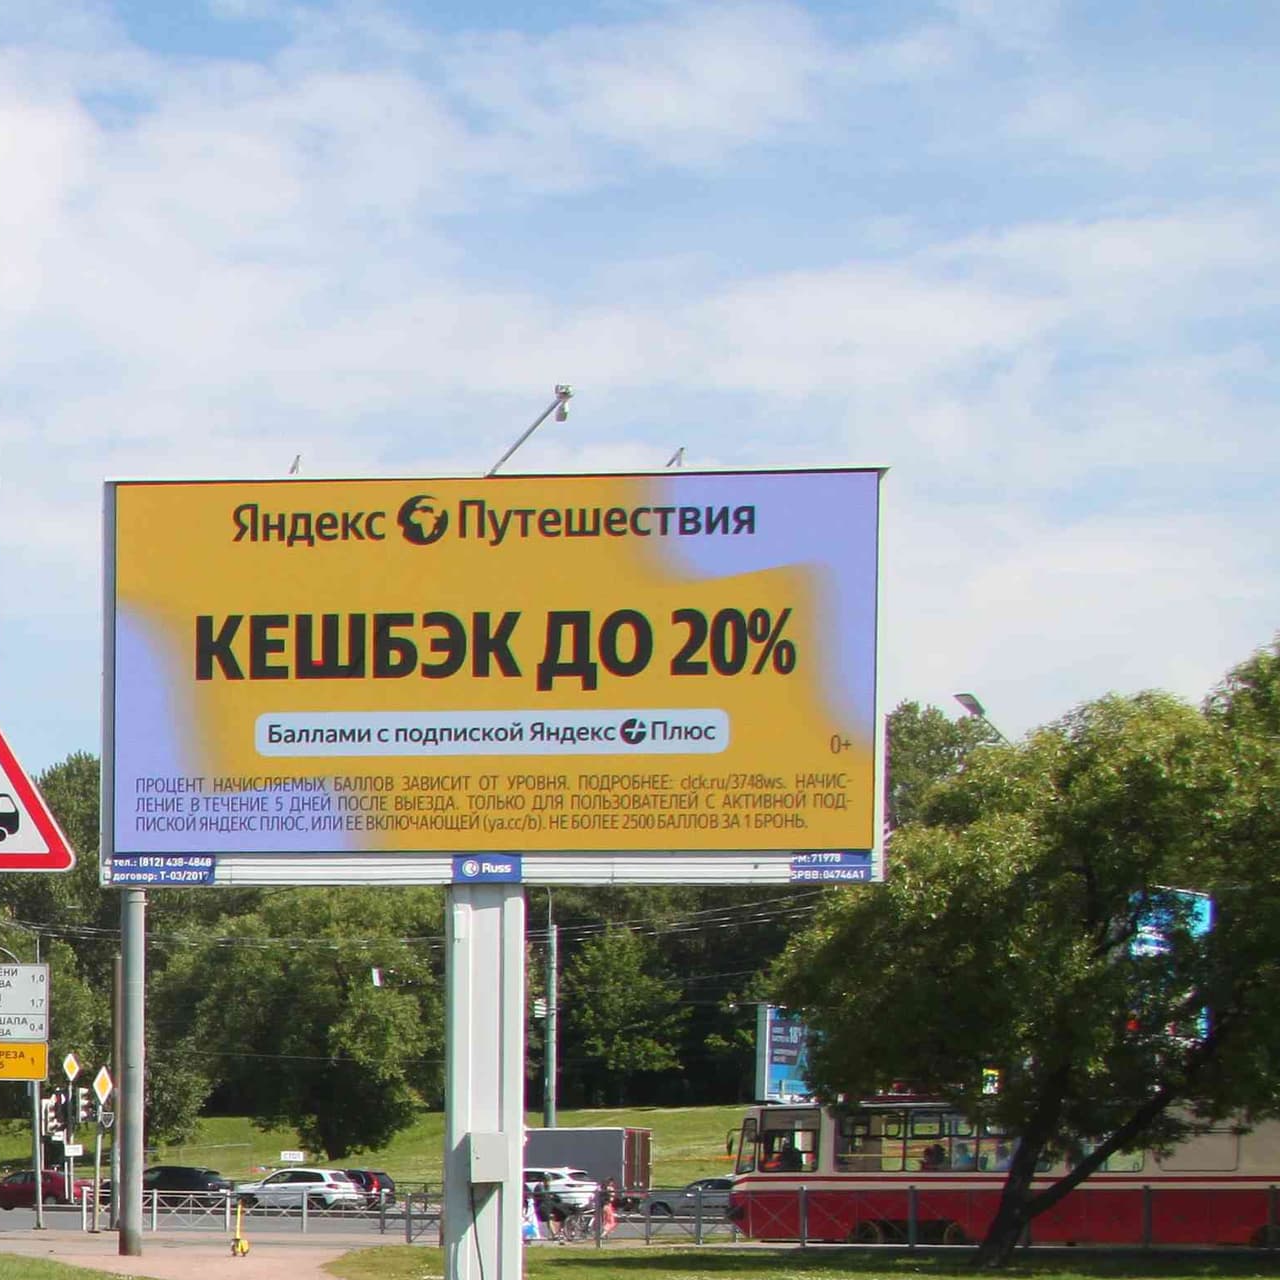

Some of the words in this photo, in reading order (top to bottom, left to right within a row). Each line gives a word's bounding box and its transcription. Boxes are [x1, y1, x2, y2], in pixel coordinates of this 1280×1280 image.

[231, 503, 386, 547] Яндекс
[458, 500, 757, 546] Путешествия
[195, 610, 523, 681] КЕШБЭК
[536, 608, 654, 692] ДО
[670, 607, 797, 677] 20%
[267, 723, 372, 744] Баллами
[376, 728, 390, 743] с
[394, 721, 524, 748] подпиской
[529, 721, 616, 745] Яндекс
[650, 720, 717, 742] Плюс
[830, 735, 853, 755] 0+
[135, 777, 205, 794] ПРОЦЕНТ
[212, 777, 326, 793] НАЧИСЛЯЕМЫХ
[333, 776, 395, 792] БАЛЛОВ
[401, 776, 471, 792] ЗАВИСИТ
[478, 775, 499, 791] ОТ
[507, 774, 570, 791] УРОВНЯ.
[578, 774, 673, 792] ПОДРОБНЕЕ:
[795, 773, 853, 790] НАЧИС-
[135, 797, 184, 813] ЛЕНИЕ
[190, 797, 200, 812] В
[203, 796, 268, 812] ТЕЧЕНИЕ
[274, 796, 283, 812] 5
[289, 793, 331, 814] ДНЕЙ
[337, 796, 387, 812] ПОСЛЕ
[394, 795, 459, 814] ВЫЕЗДА.
[467, 795, 525, 810] ТОЛЬКО
[532, 795, 564, 812] ДЛЯ
[570, 790, 698, 810] ПОЛЬЗОВАТЕЛЕЙ
[705, 793, 715, 809] С
[722, 790, 806, 809] АКТИВНОЙ
[813, 792, 853, 810] ПОД-
[136, 813, 196, 832] ПИСКОЙ
[199, 816, 257, 832] ЯНДЕКС
[260, 816, 308, 833] ПЛЮС,
[311, 815, 343, 831] ИЛИ
[345, 815, 363, 831] ЕЕ
[366, 812, 480, 832] ВКЛЮЧАЮЩЕЙ
[549, 814, 571, 830] НЕ
[572, 814, 621, 830] БОЛЕЕ
[622, 814, 655, 830] 2500
[657, 814, 719, 829] БАЛЛОВ
[721, 813, 740, 829] ЗА
[743, 813, 750, 829] 1
[754, 813, 808, 829] БРОНЬ.
[113, 859, 137, 867] тел.:
[139, 857, 164, 867] (812)
[481, 863, 513, 873] Russ
[113, 872, 158, 882] договор:
[31, 974, 45, 984] 1,0
[31, 999, 44, 1008] 1,7
